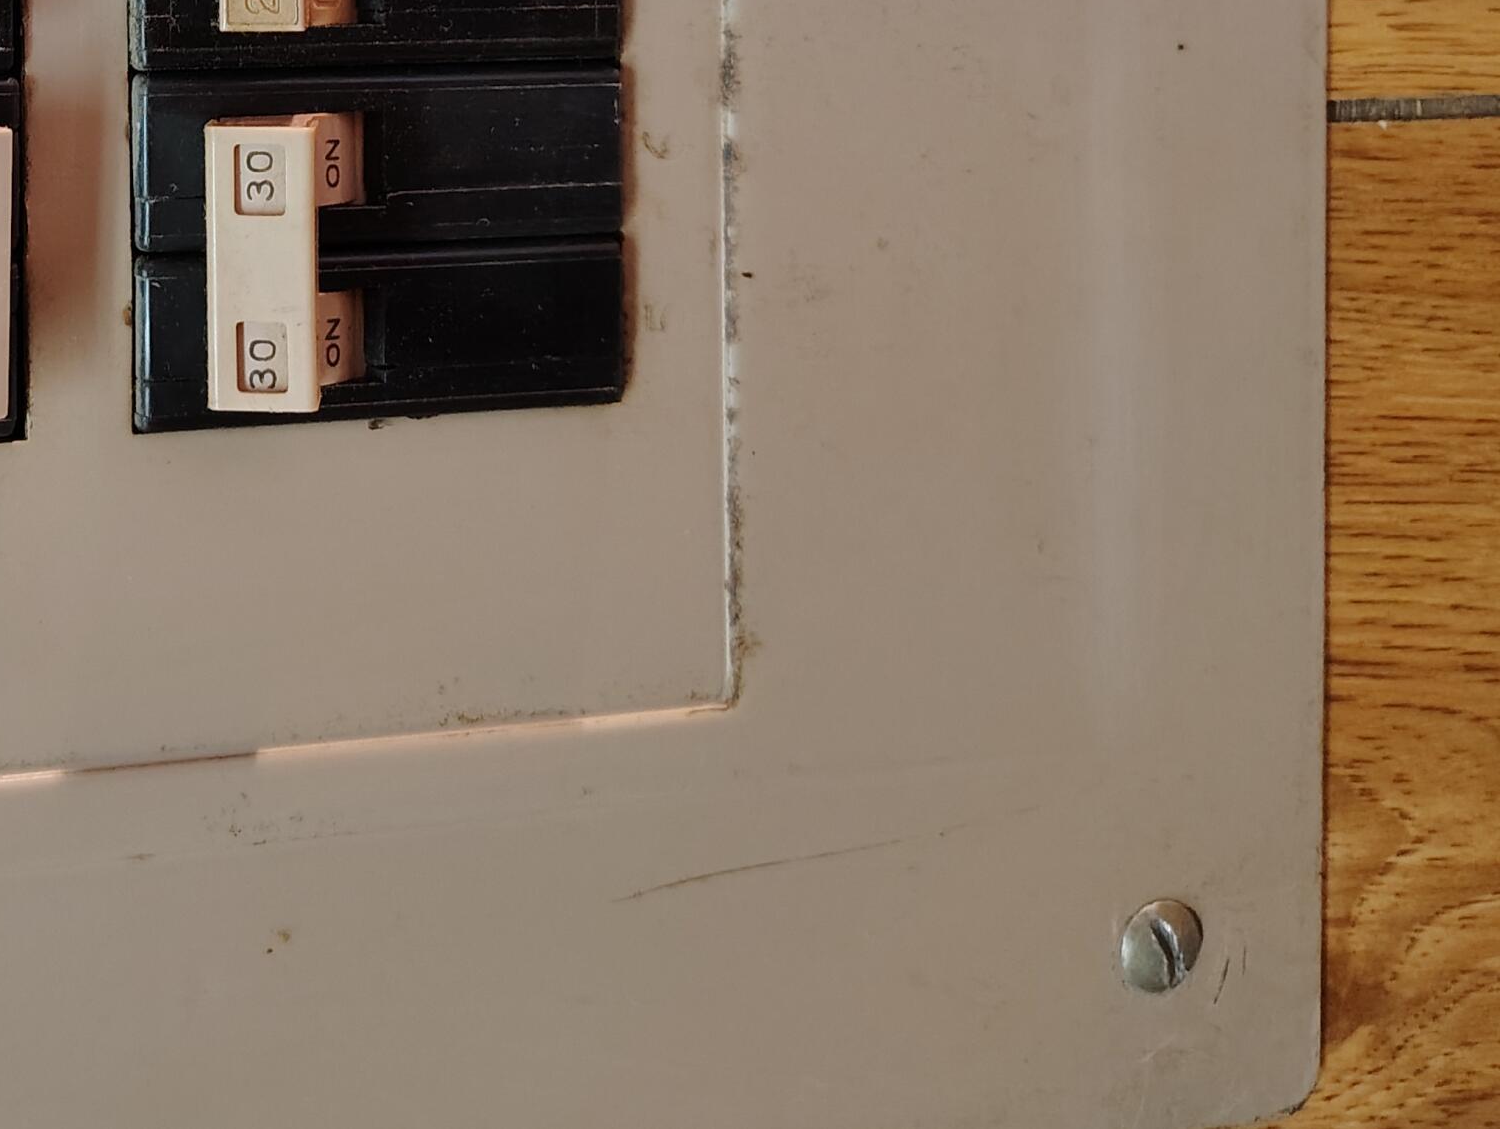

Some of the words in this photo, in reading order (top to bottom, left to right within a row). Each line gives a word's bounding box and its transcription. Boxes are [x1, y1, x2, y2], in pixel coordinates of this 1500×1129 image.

[246, 150, 275, 201] 30
[325, 139, 341, 188] ON
[249, 339, 277, 389] 30
[325, 318, 341, 368] ON
